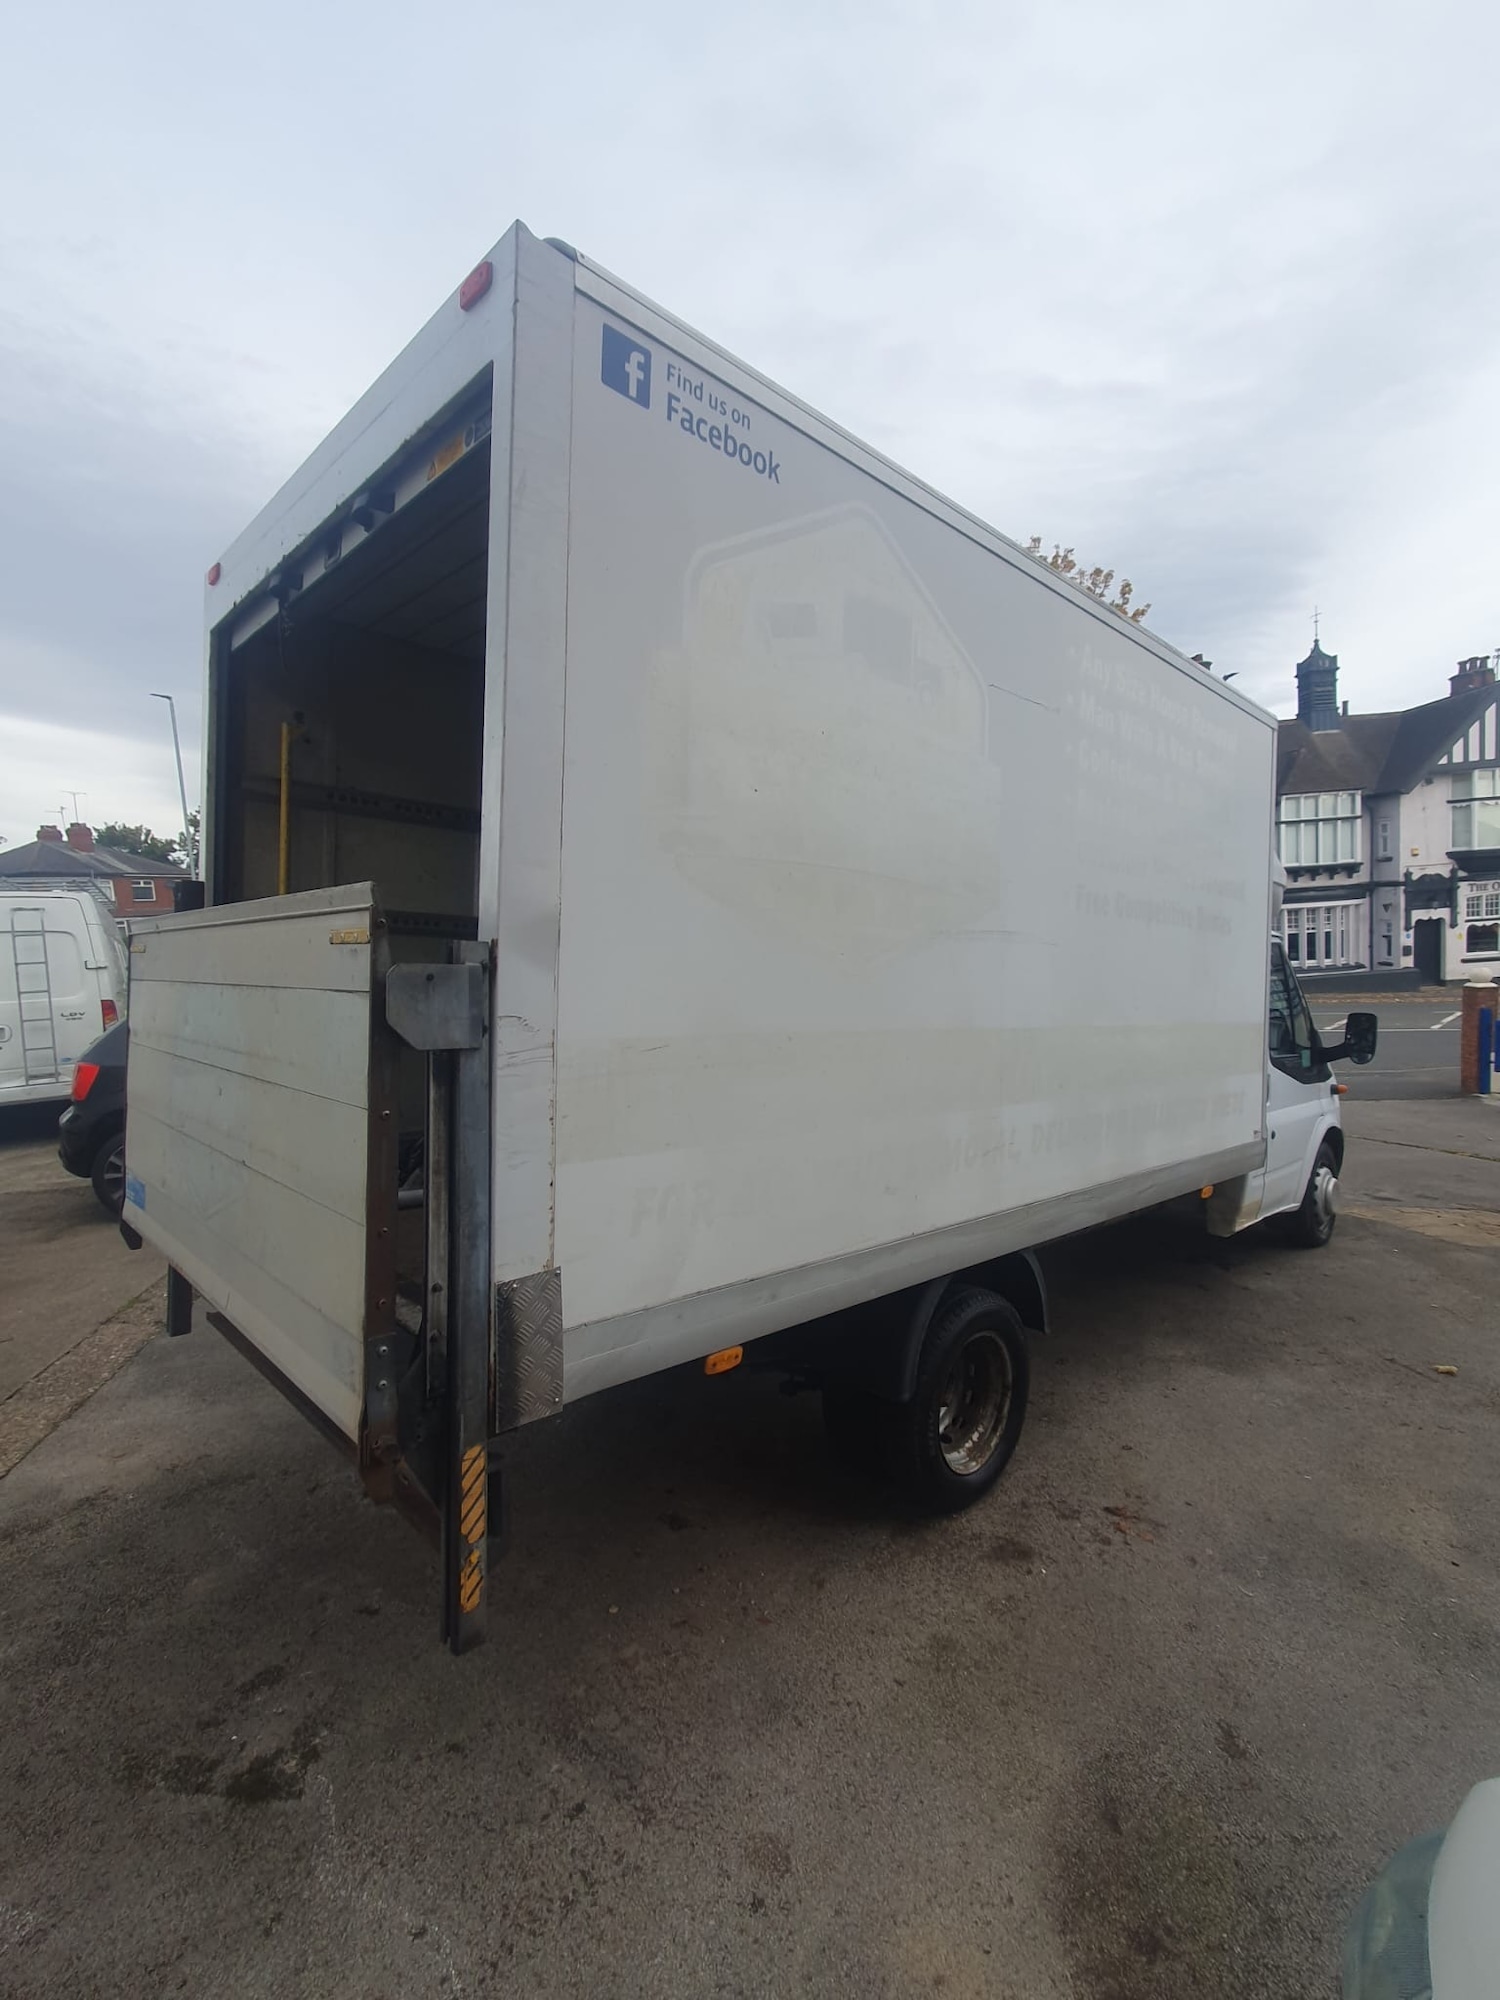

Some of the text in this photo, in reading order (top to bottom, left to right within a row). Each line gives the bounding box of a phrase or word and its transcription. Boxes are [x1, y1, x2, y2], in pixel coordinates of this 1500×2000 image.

[625, 351, 644, 398] f
[666, 362, 751, 430] Find us on
[666, 392, 781, 484] Facebook
